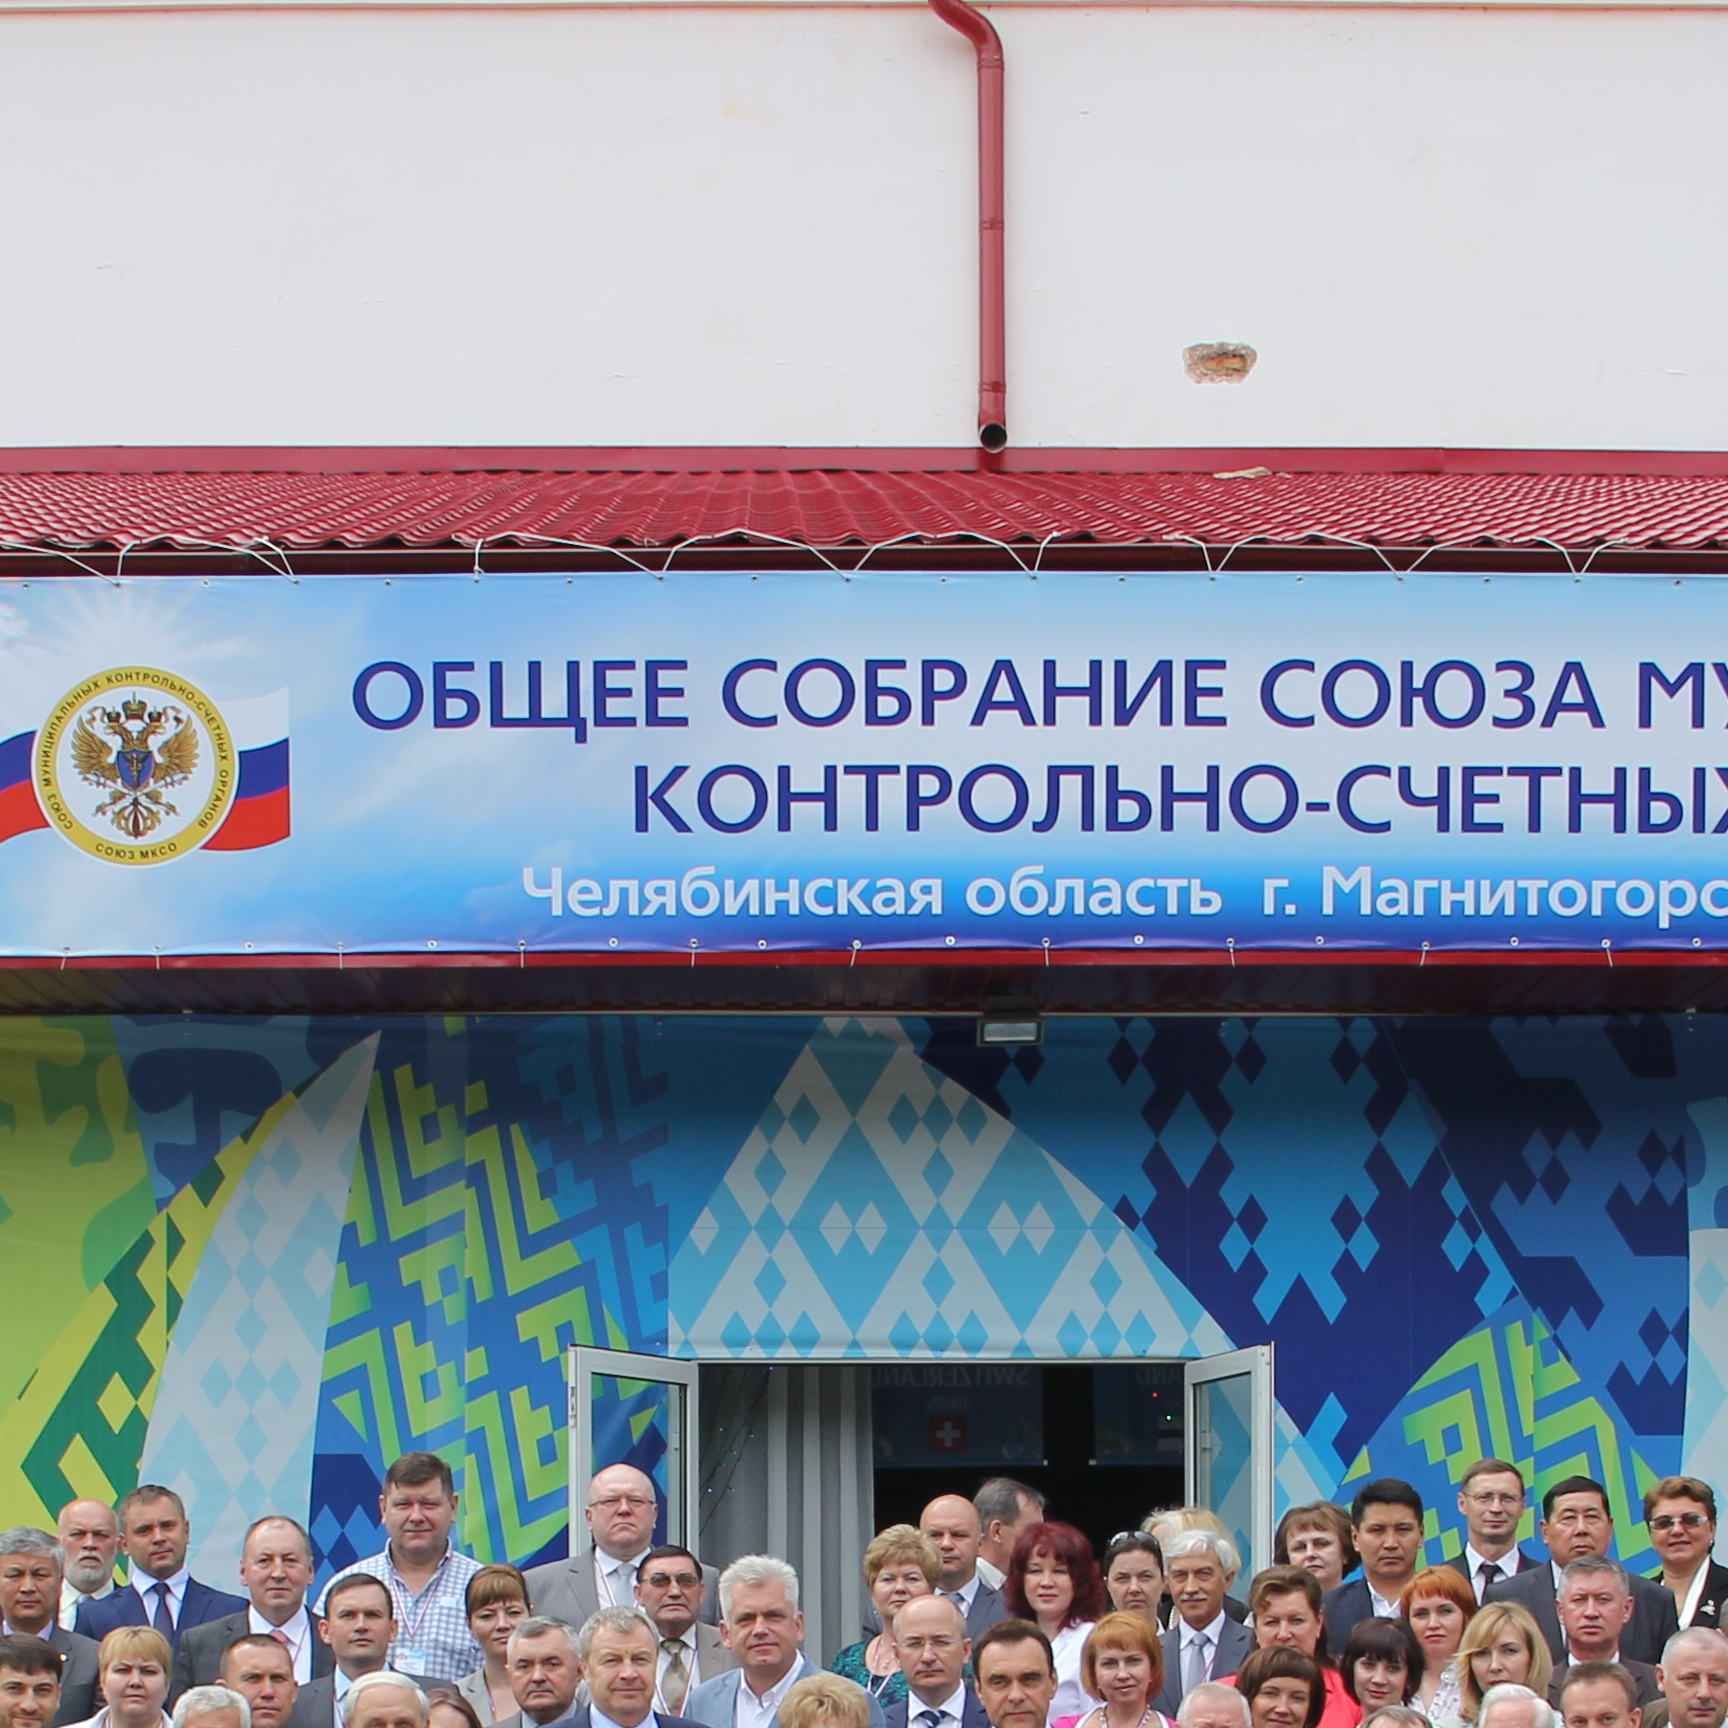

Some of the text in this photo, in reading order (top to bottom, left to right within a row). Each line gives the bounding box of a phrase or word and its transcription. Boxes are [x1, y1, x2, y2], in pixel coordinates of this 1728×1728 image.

[351, 659, 690, 745] ОБЩЕЕ
[721, 657, 1228, 728] СОБРАНИЕ
[1259, 658, 1606, 730] СОЮЗА
[41, 671, 229, 830] СОЮЗ МУНИЦИПАЛЬНЫХ КОНТРОЛЬНО-СЧЕТНЫХ ОРГАНОВ
[95, 842, 177, 860] СОЮЗ МКСО
[521, 864, 943, 918] Челябинская
[965, 863, 1223, 917] область
[1262, 877, 1297, 917] г.
